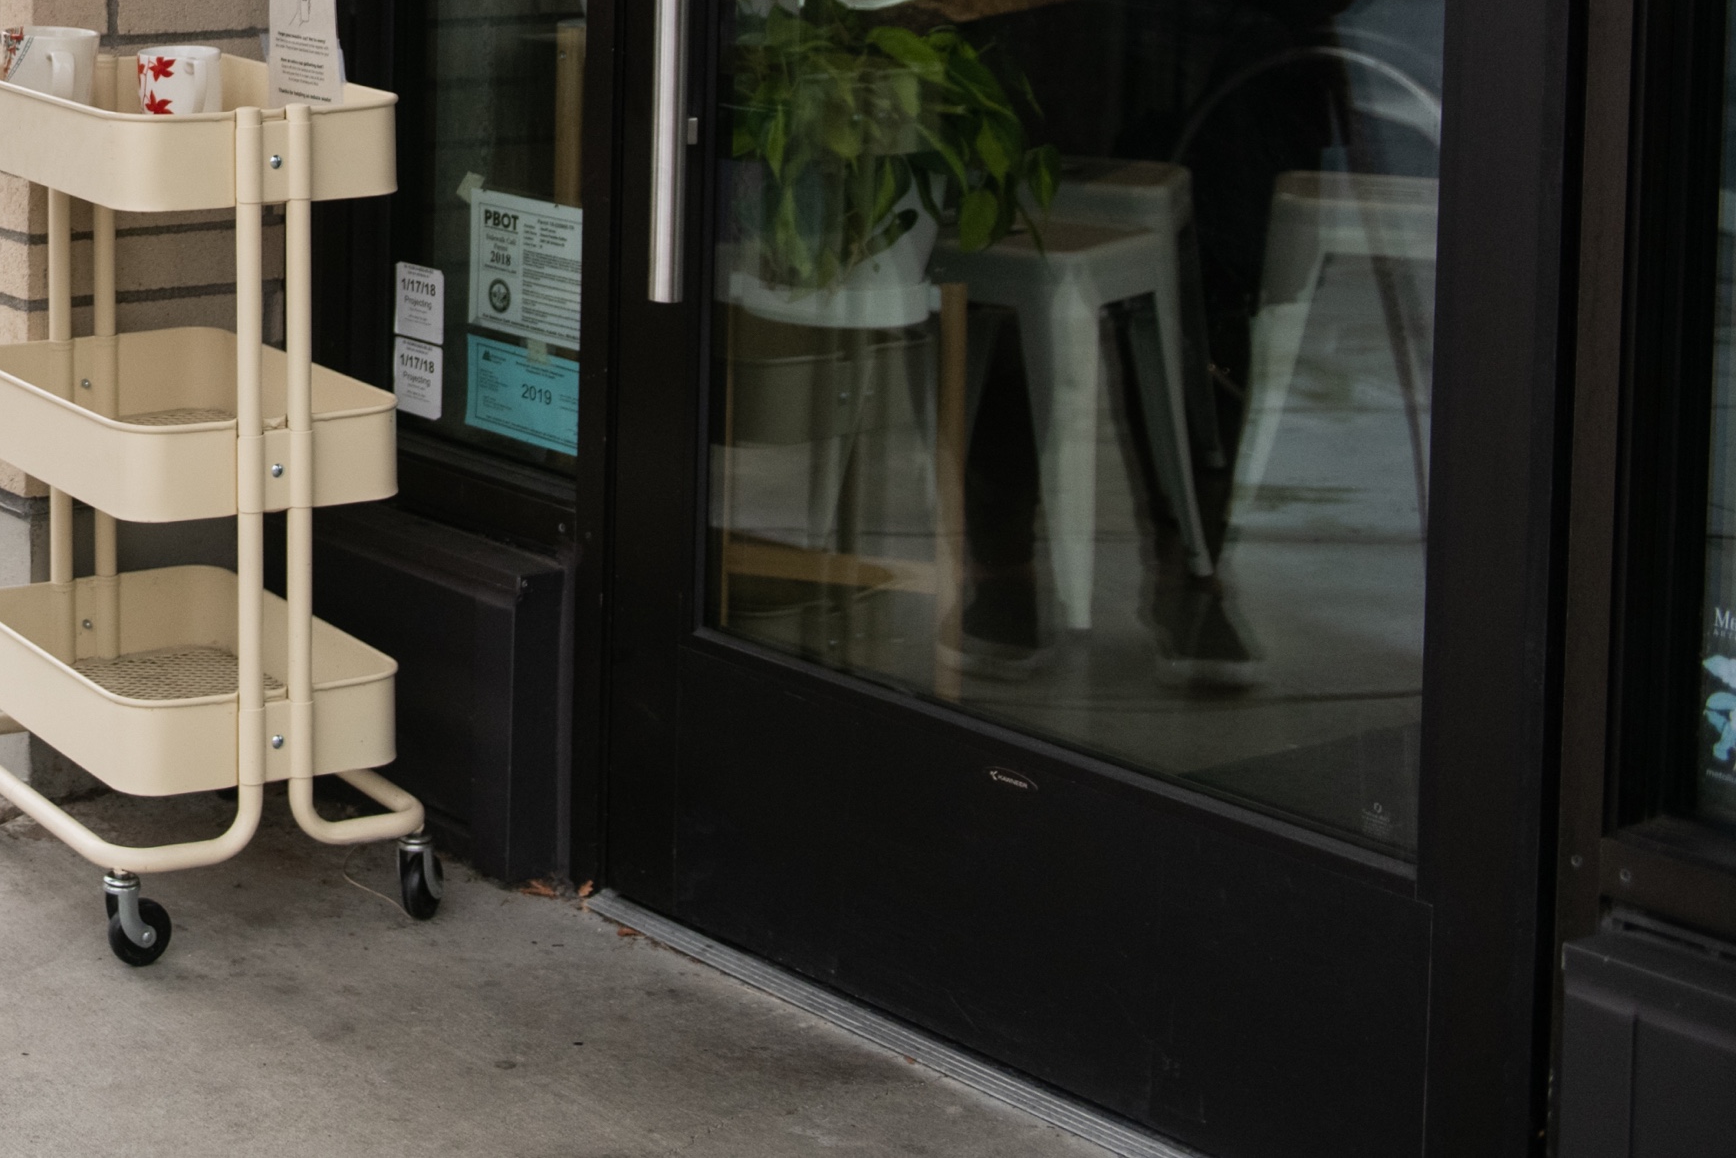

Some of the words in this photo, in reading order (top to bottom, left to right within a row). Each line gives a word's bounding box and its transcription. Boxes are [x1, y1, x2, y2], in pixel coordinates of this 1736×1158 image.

[484, 209, 519, 230] PBOT
[490, 250, 511, 266] 2018
[401, 278, 436, 297] 1/17/18
[404, 295, 432, 311] Projecting
[400, 352, 435, 374] 1/17/18
[403, 371, 431, 388] Projecting
[521, 383, 552, 406] 2019
